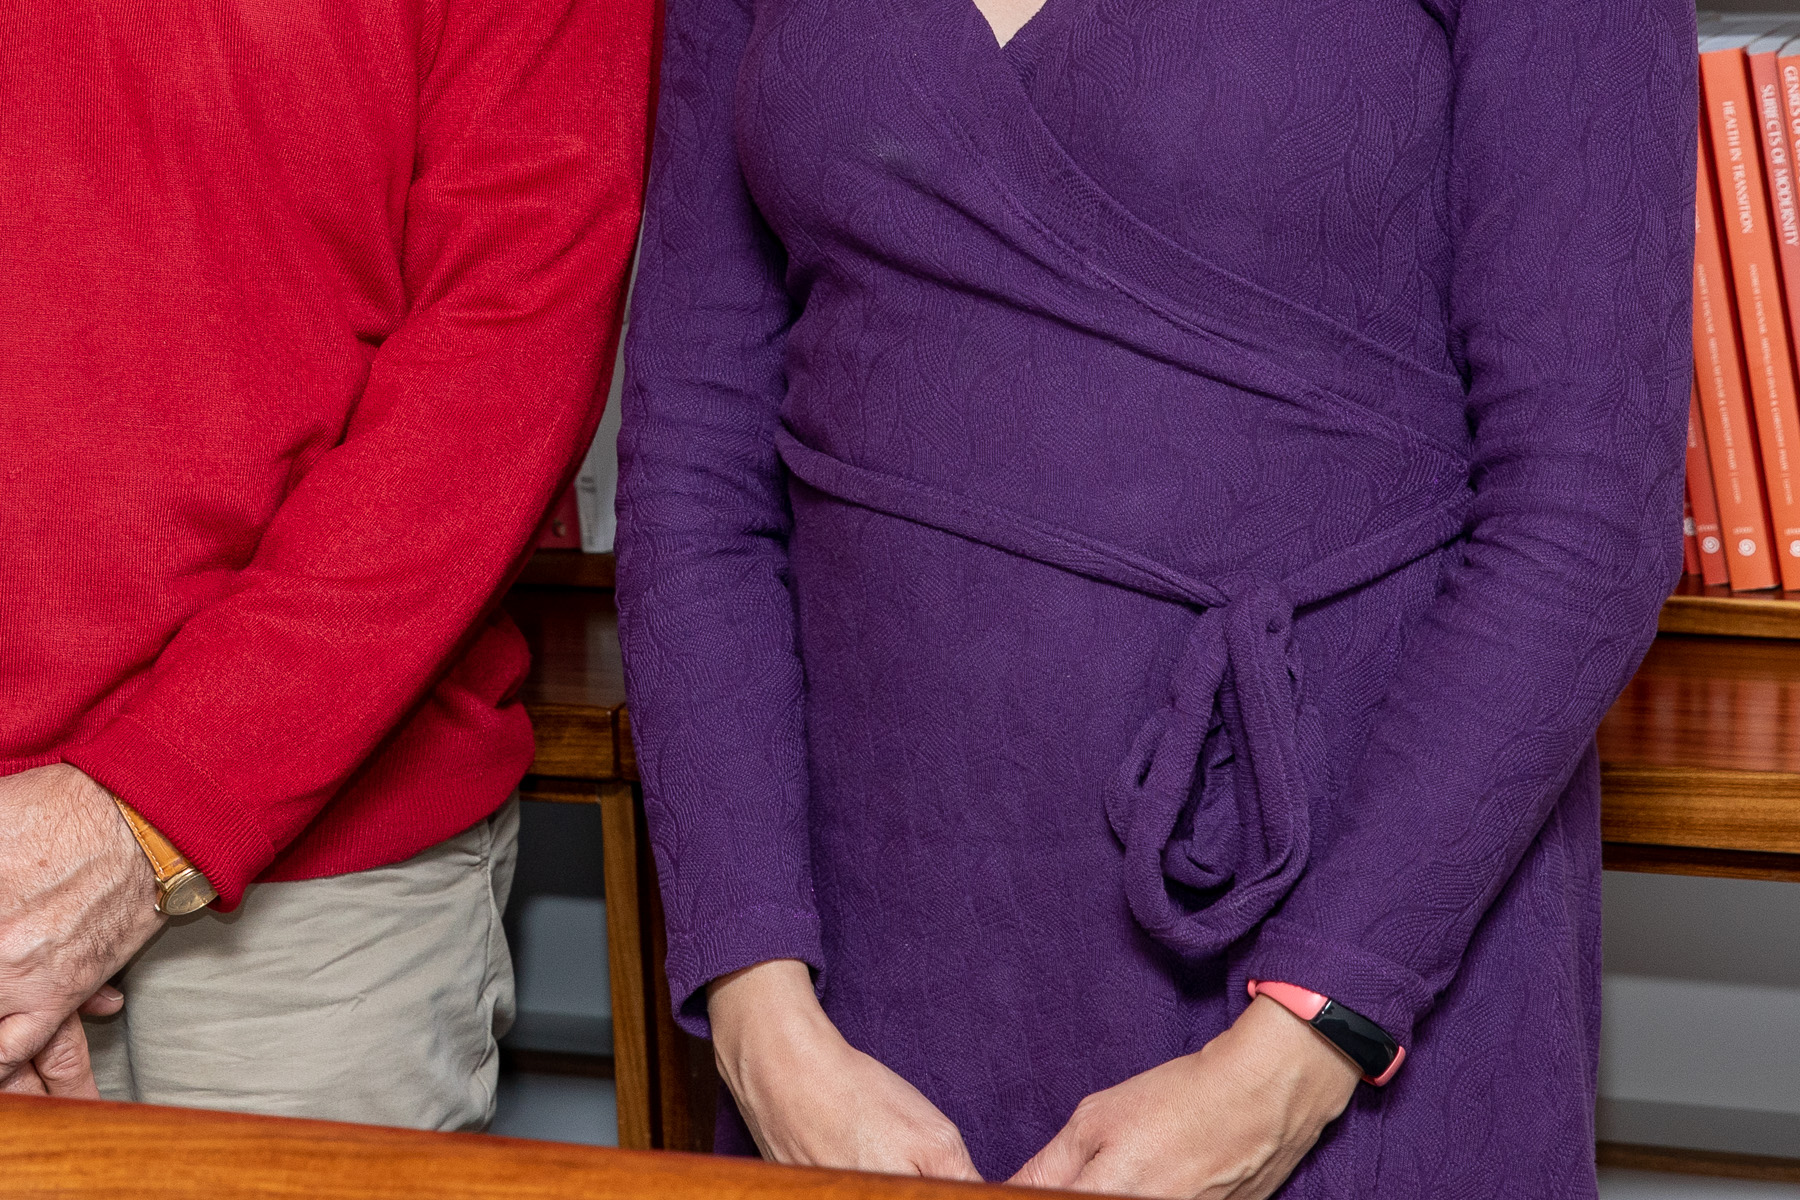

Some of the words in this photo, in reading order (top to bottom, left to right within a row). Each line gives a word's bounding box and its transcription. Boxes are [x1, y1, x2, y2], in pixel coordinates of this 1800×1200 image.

[1722, 100, 1741, 147] HEALTH
[1760, 83, 1783, 147] SUBJECTS
[1730, 147, 1743, 162] IN
[1769, 147, 1786, 165] OF
[1732, 164, 1754, 234] TRANSITION
[1774, 167, 1799, 247] MODERNITY
